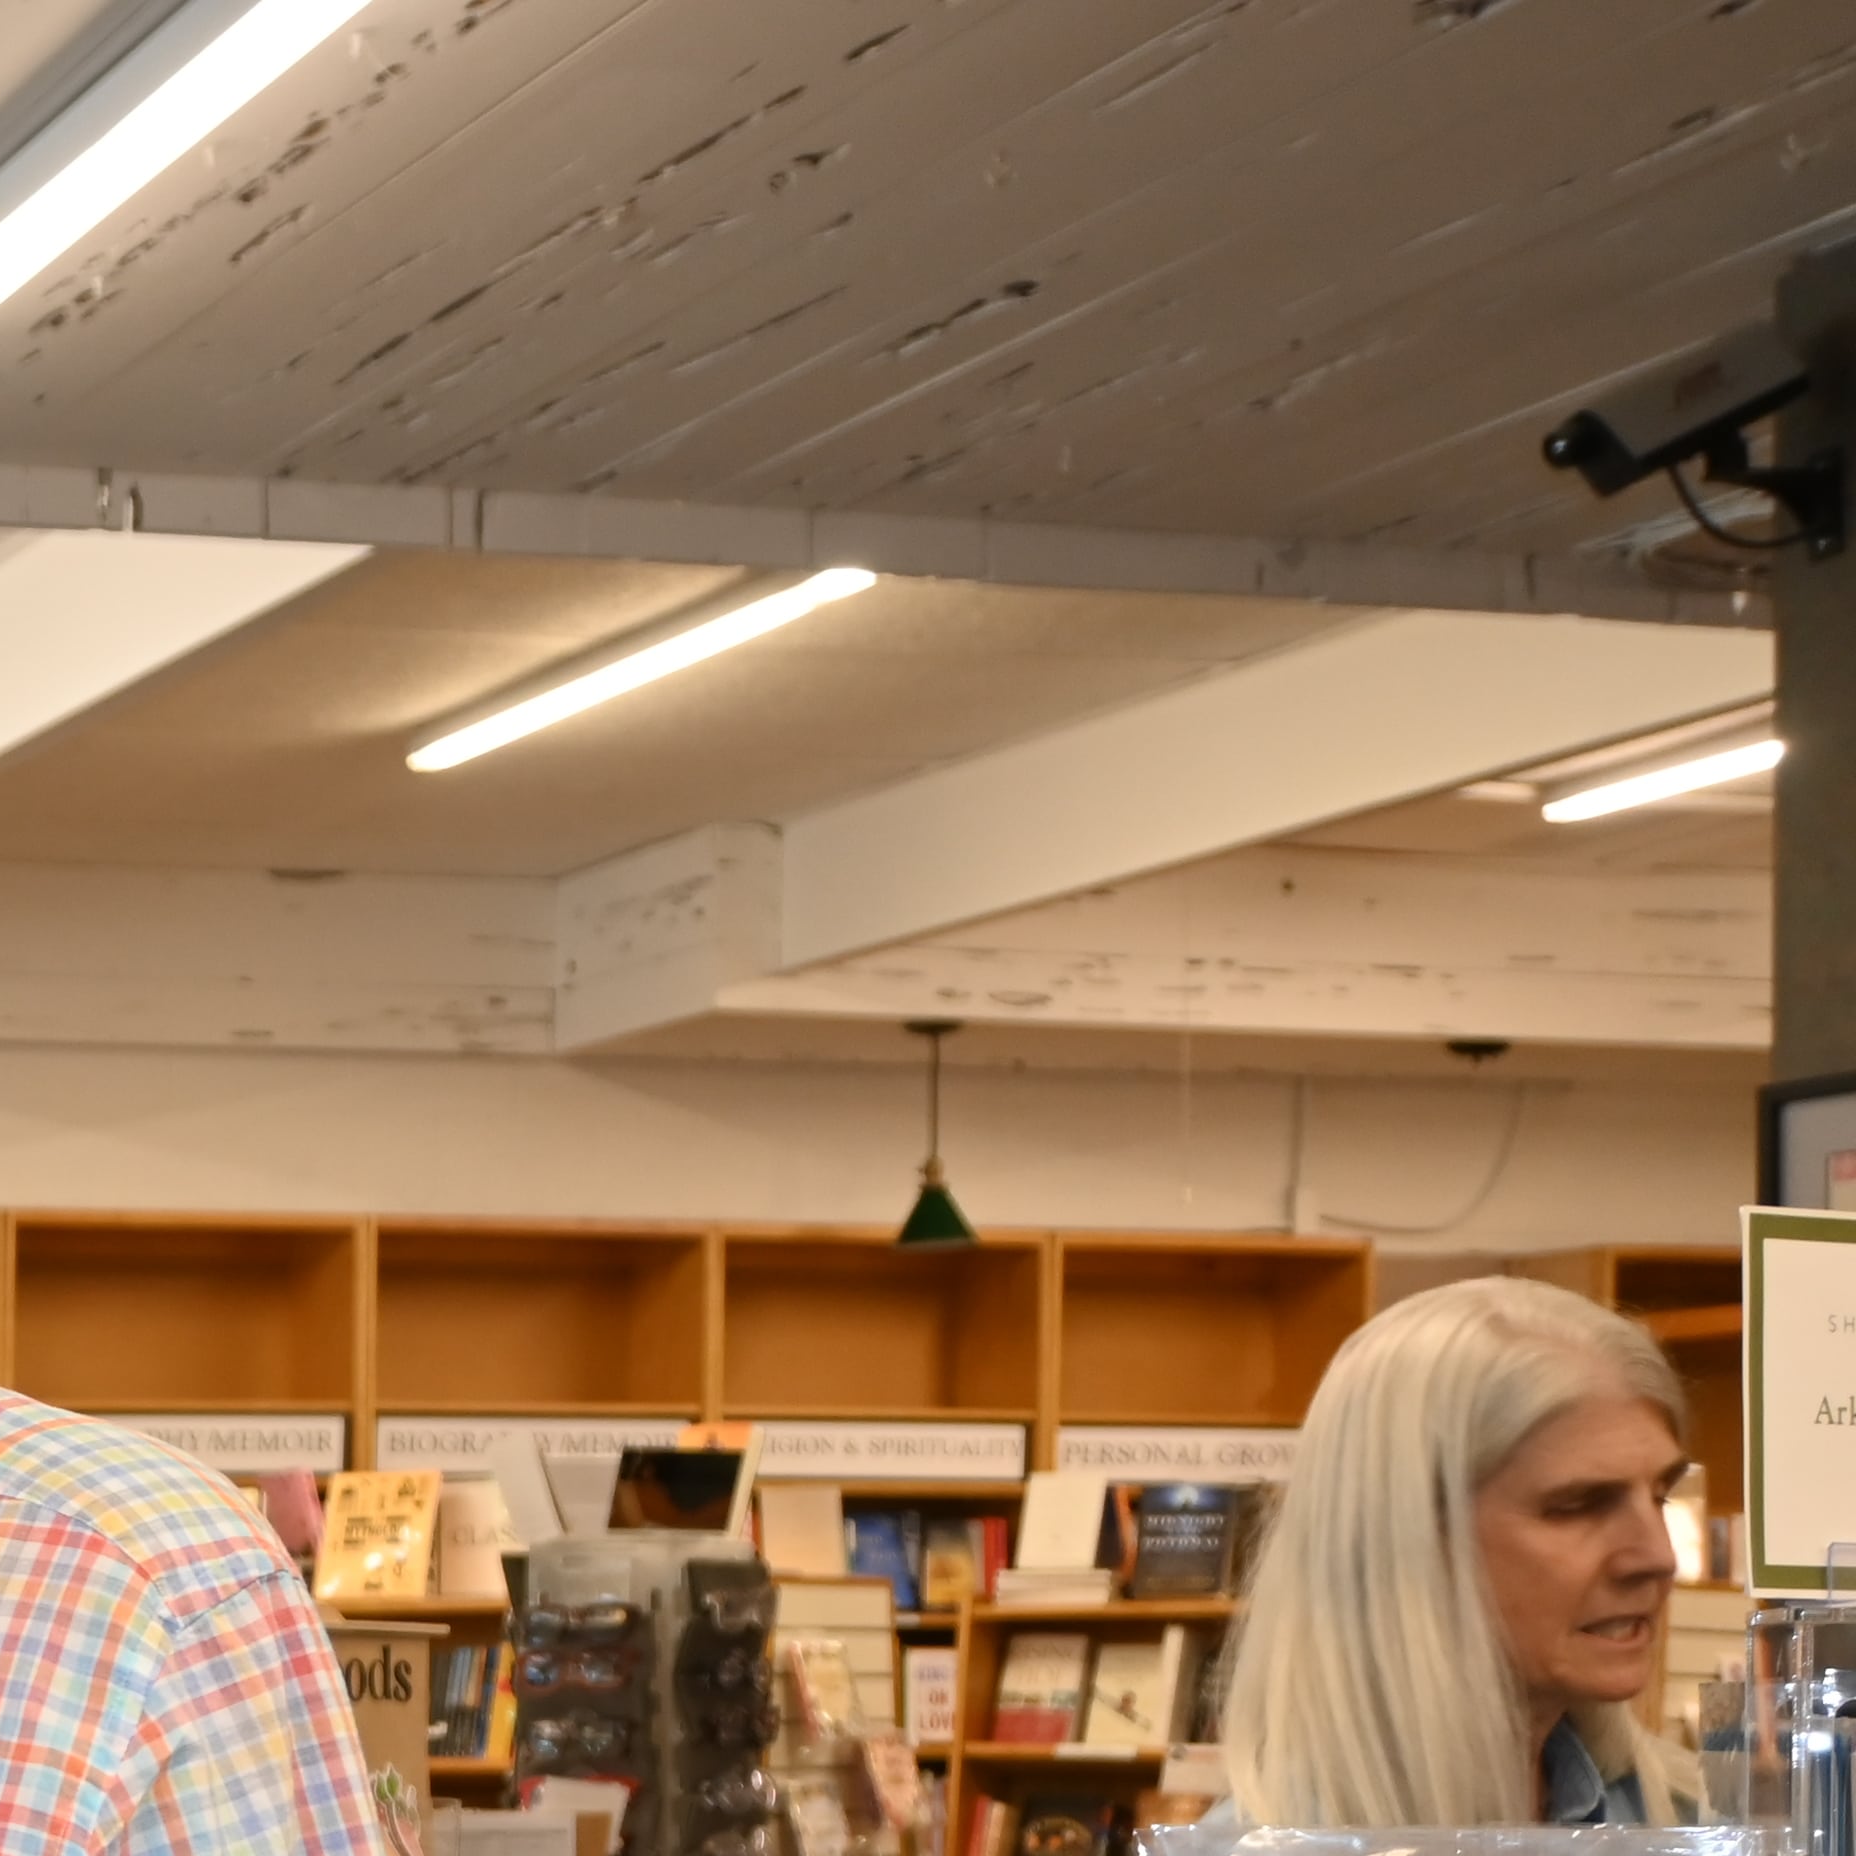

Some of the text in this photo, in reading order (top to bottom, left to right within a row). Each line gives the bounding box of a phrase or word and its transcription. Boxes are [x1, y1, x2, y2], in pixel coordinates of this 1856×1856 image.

[842, 1436, 859, 1457] &
[867, 1437, 1025, 1460] SPIRITUALITY
[1063, 1442, 1208, 1468] PERSONAL
[339, 1643, 413, 1702] ods
